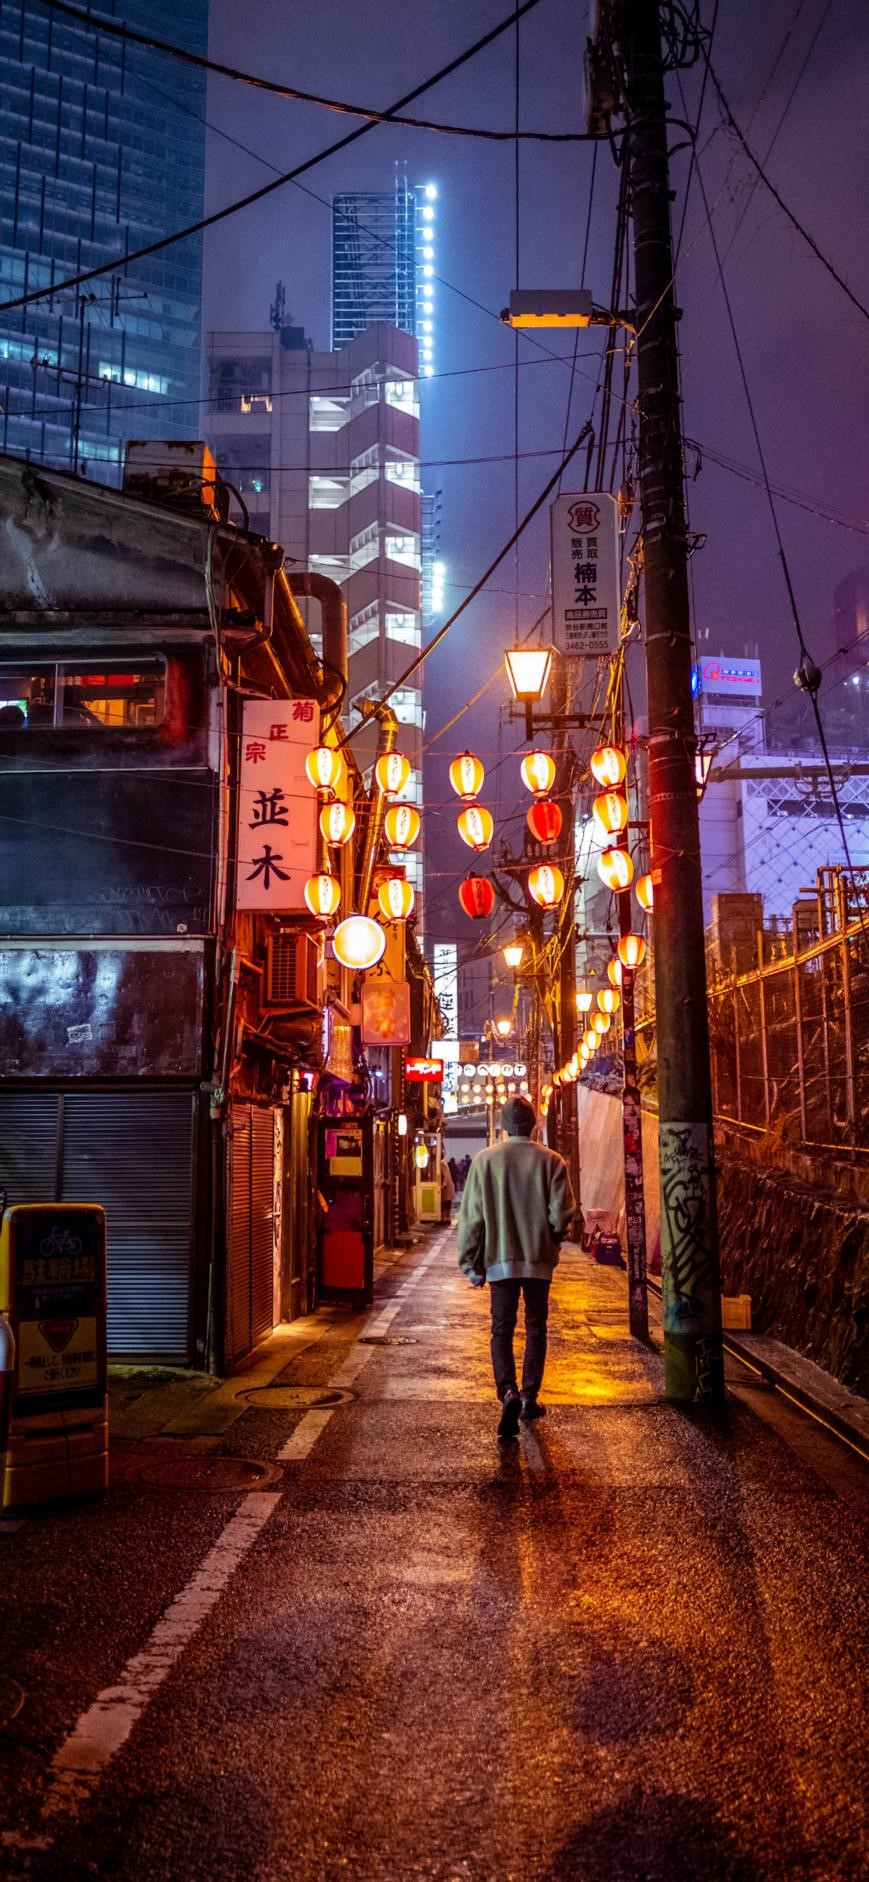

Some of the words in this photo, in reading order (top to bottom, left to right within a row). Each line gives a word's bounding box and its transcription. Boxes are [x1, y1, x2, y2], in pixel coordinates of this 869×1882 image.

[574, 507, 593, 527] 質
[586, 537, 598, 559] 買取
[574, 562, 597, 606] 楠本
[245, 701, 314, 764] 菊正宗
[246, 789, 291, 890] 並木
